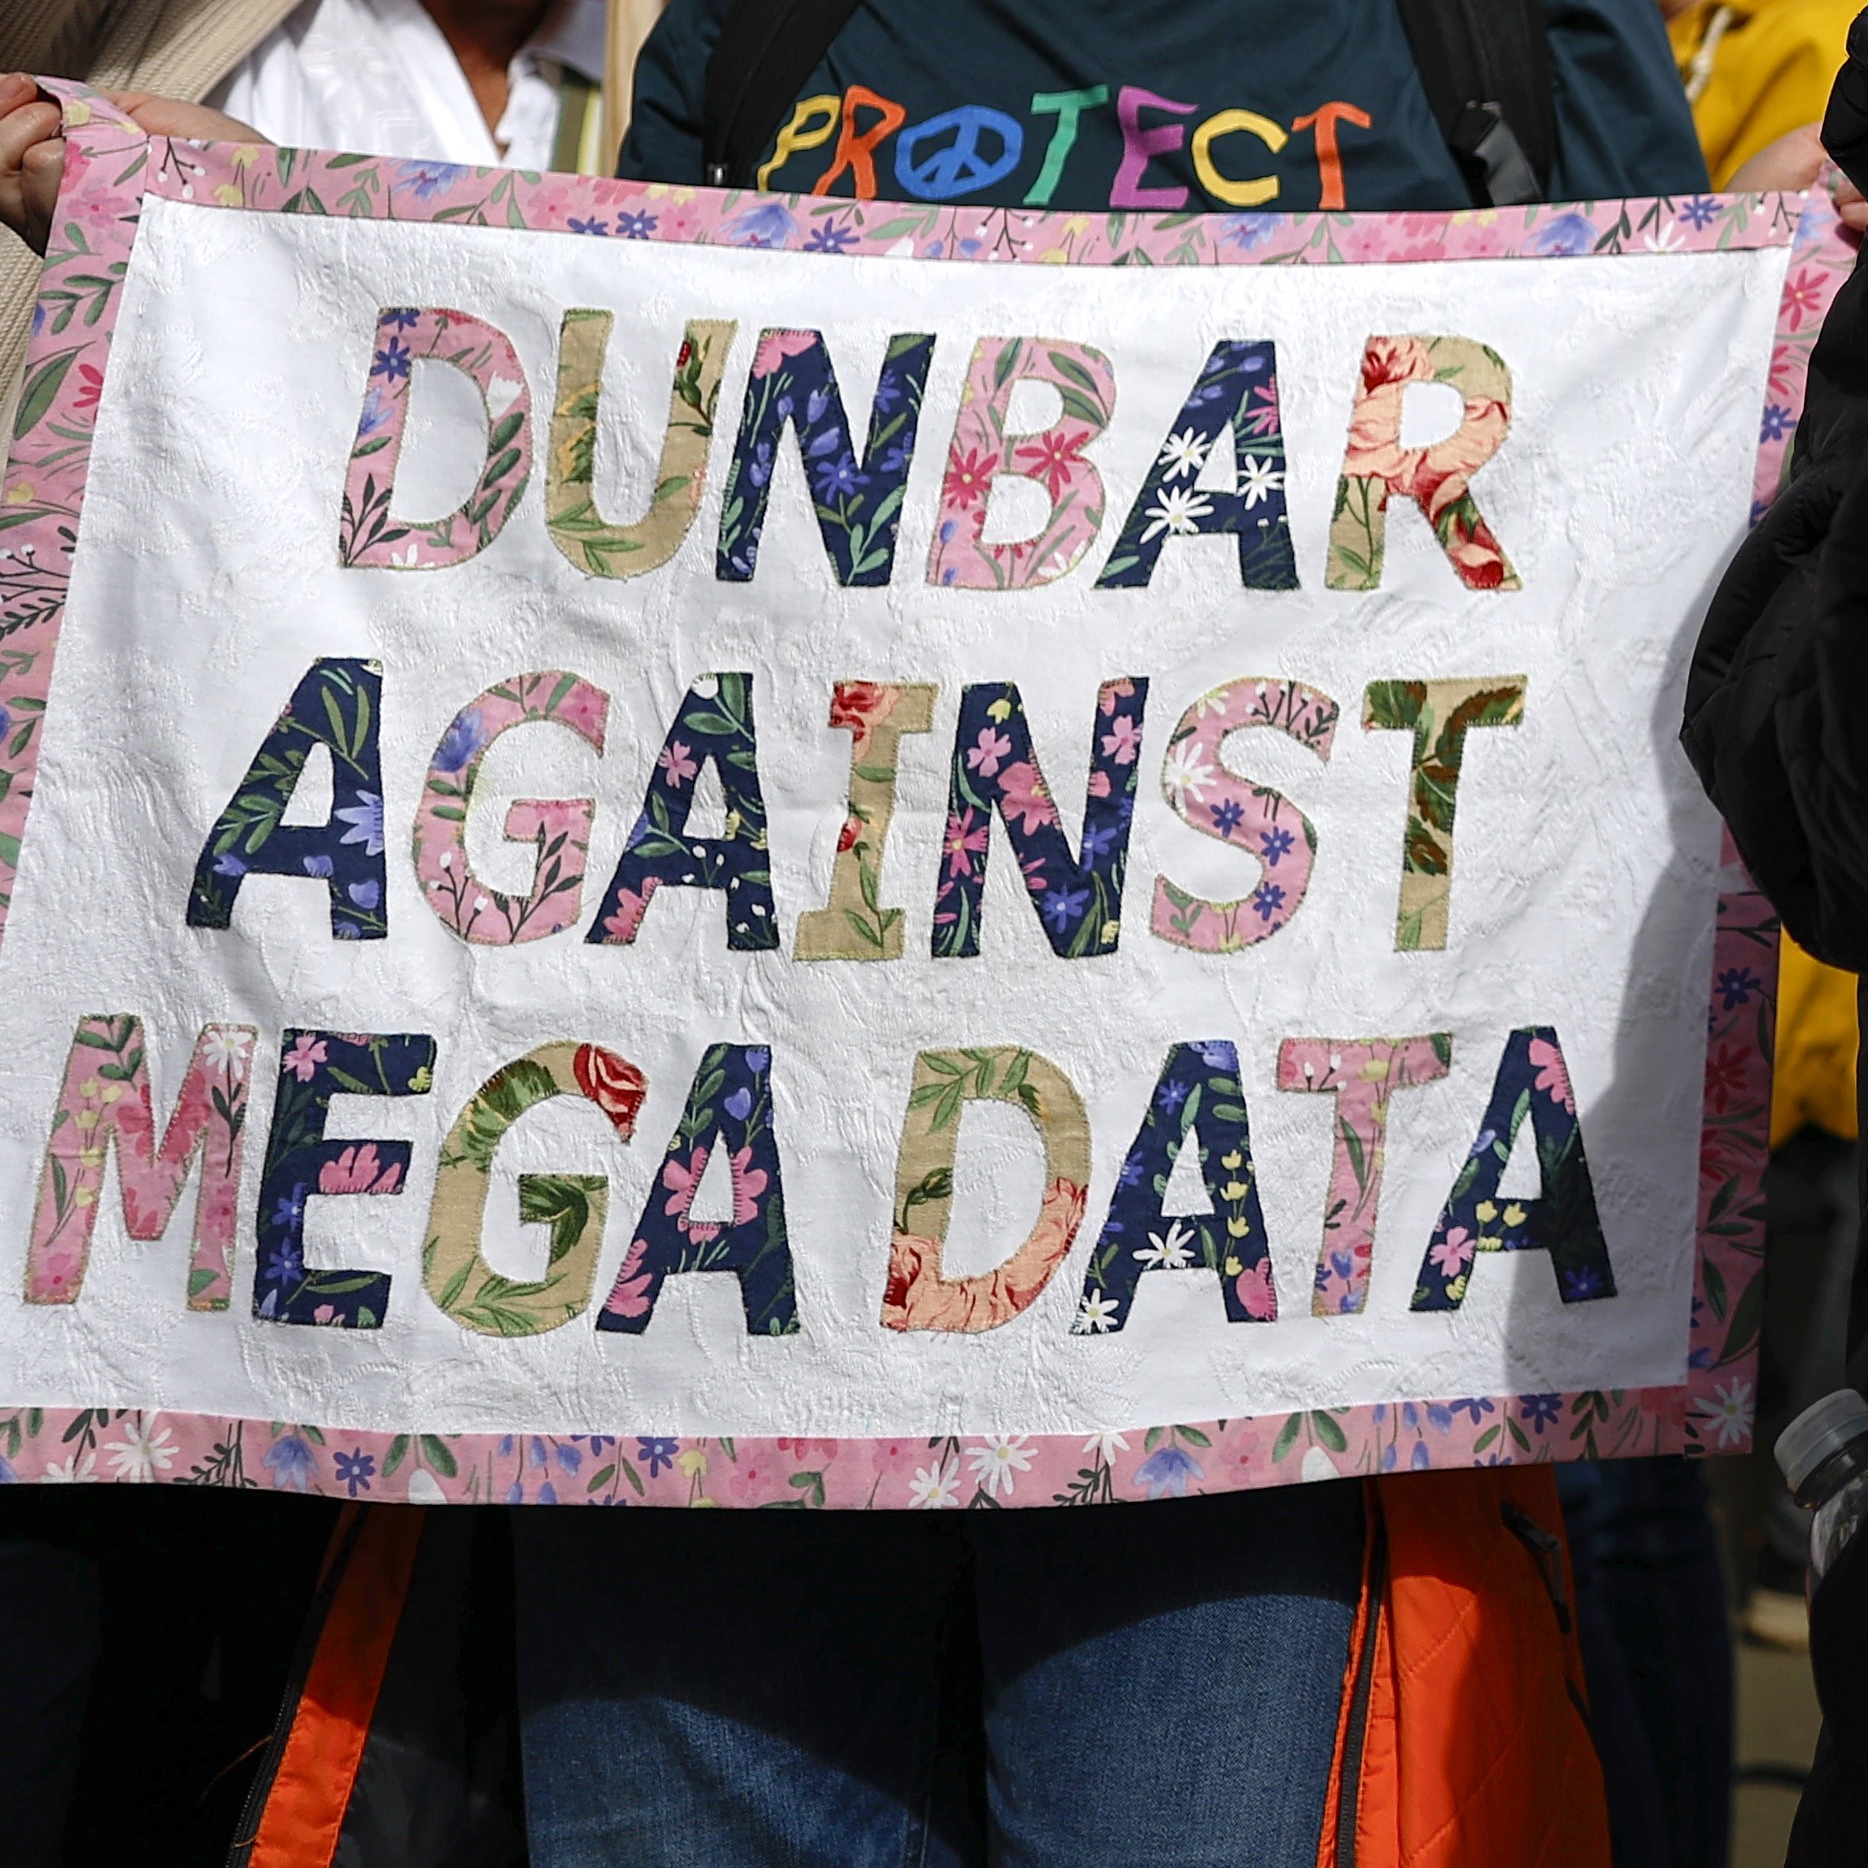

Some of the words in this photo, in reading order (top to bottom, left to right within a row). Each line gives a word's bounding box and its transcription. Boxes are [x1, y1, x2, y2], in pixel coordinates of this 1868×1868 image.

[756, 84, 1373, 210] PROTECT
[338, 306, 1524, 592] DUNBAR
[184, 656, 1528, 962] AGAINST
[21, 1012, 802, 1336] MEGA
[877, 1023, 1617, 1336] DATA
